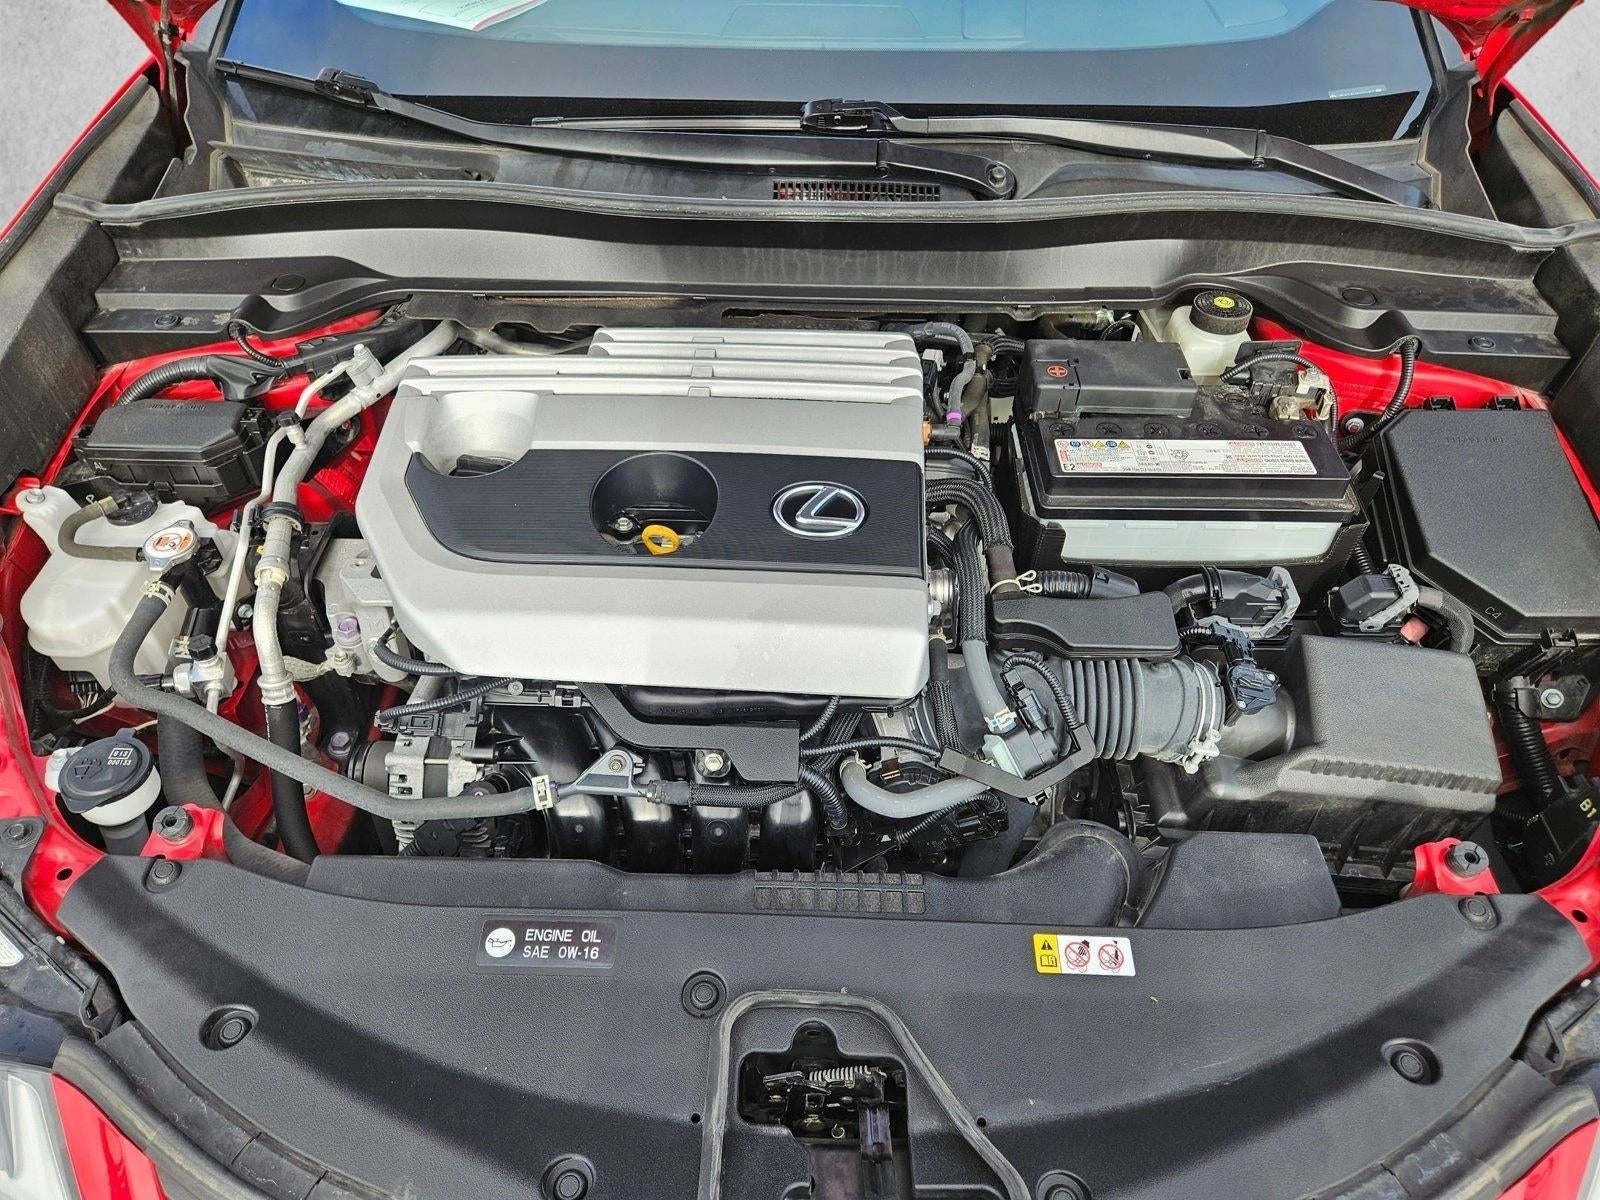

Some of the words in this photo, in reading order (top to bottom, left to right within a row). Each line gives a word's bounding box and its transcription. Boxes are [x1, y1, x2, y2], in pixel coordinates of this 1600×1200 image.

[1580, 798, 1597, 818] B1
[525, 929, 573, 942] ENGINE
[581, 930, 601, 943] OIL
[523, 946, 550, 958] SAE
[558, 947, 600, 959] 0W-16
